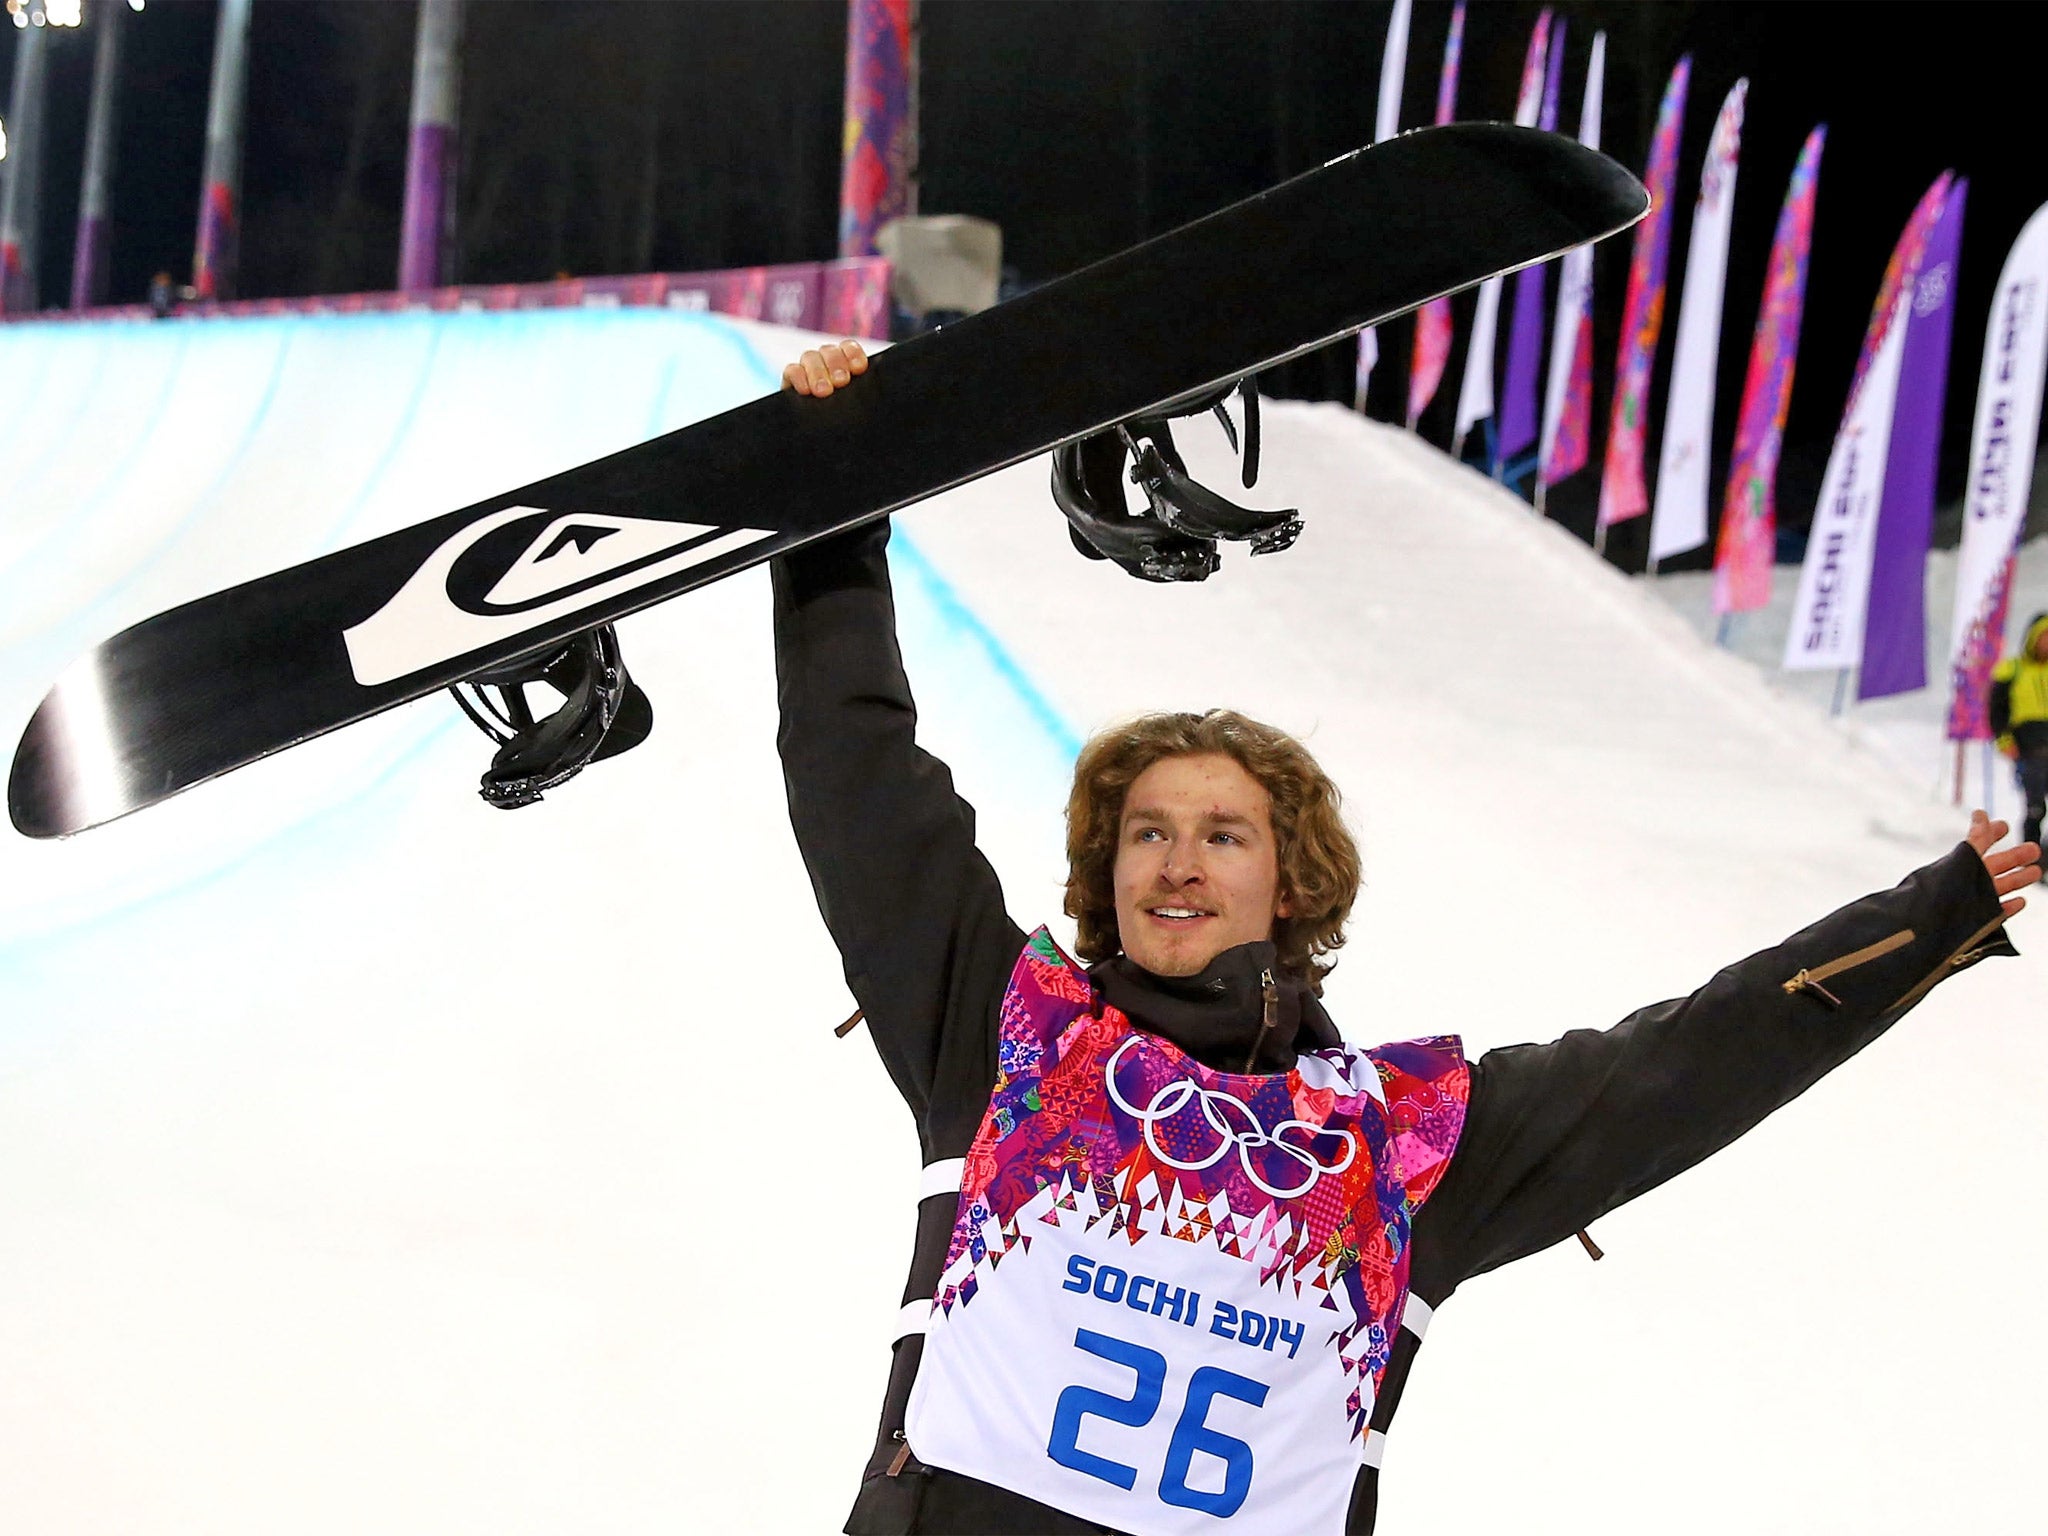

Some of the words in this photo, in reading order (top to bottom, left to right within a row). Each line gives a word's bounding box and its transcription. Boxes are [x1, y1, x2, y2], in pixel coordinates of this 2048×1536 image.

[1062, 1254, 1200, 1327] SOCHI
[1209, 1300, 1305, 1360] 2014
[1047, 1327, 1270, 1519] 26
